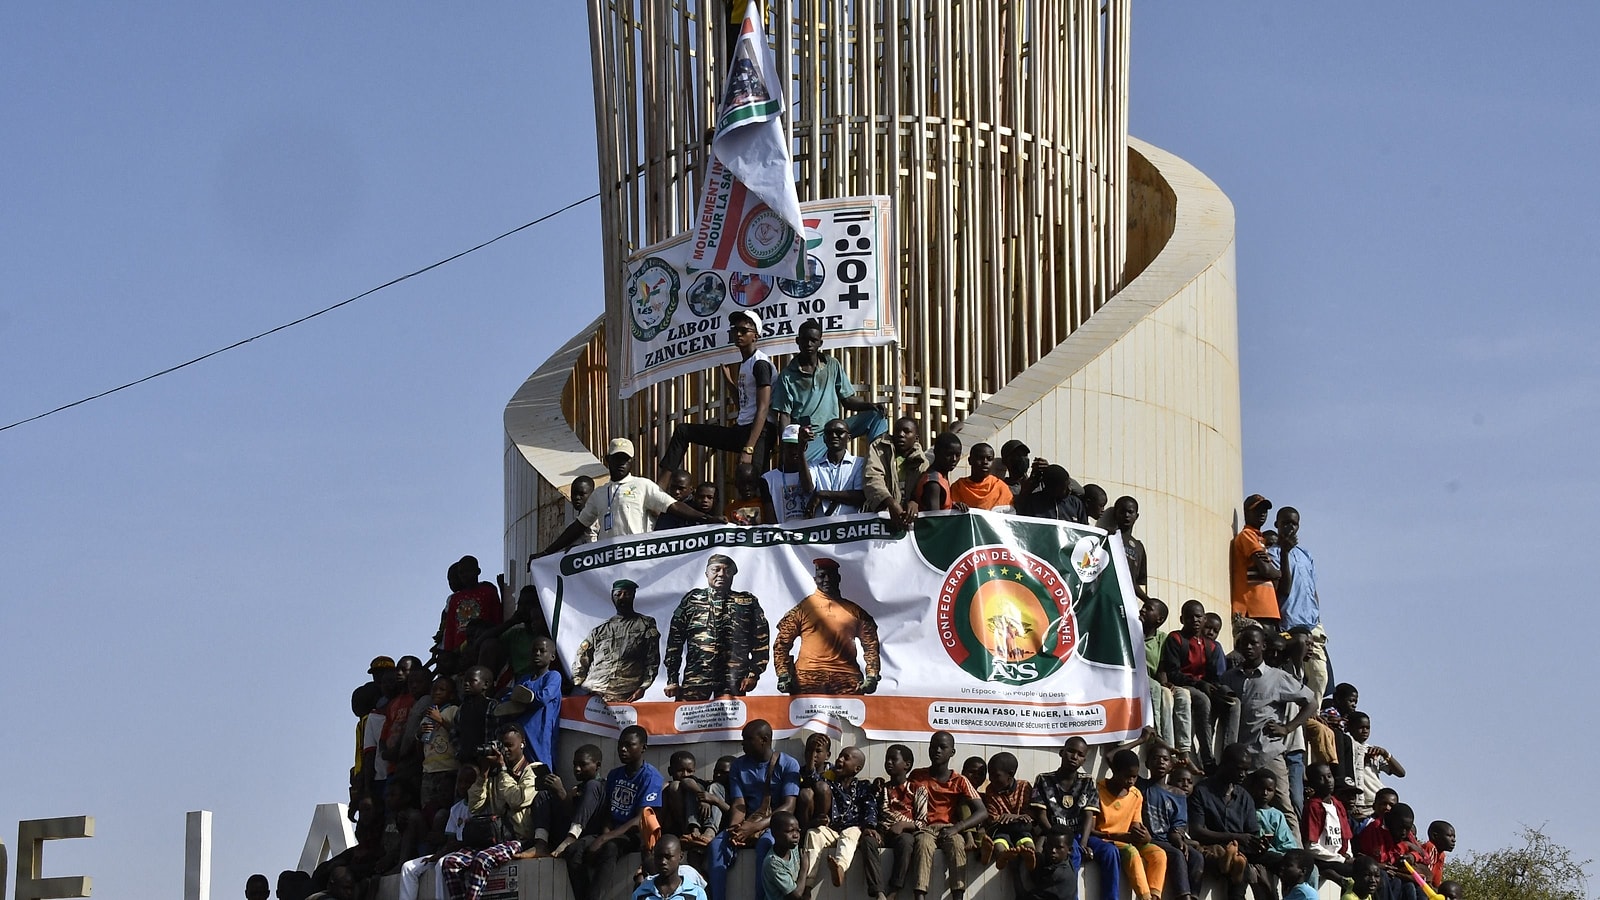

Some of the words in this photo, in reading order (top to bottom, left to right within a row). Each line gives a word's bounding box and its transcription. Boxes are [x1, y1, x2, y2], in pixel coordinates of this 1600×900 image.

[693, 178, 720, 260] MOUVEMENT
[711, 158, 723, 176] IN
[708, 213, 724, 248] POUR
[718, 194, 729, 210] LA
[667, 316, 721, 342] LABOU
[753, 302, 788, 320] NNI
[797, 299, 826, 314] NO
[644, 333, 716, 369] ZANCEN
[572, 535, 709, 569] CONFÉDÉRATION
[714, 531, 746, 544] DES
[752, 530, 804, 544] ÉTATS
[808, 529, 831, 542] DU
[836, 523, 891, 540] SAHEL
[991, 551, 1016, 561] DES
[1029, 560, 1056, 586] TATS
[940, 552, 987, 647] CONFEDERATION
[1054, 588, 1069, 605] DU
[1060, 612, 1071, 644] AHEL
[971, 688, 996, 696] Espace
[932, 718, 951, 726] AES,
[984, 719, 1016, 728] SOUVERAIN
[1059, 721, 1068, 729] DE
[948, 706, 990, 715] BURKINA
[992, 707, 1018, 717] FASO,
[1020, 709, 1030, 717] LE
[1032, 709, 1061, 718] NIGER,
[1076, 707, 1099, 716] MALI
[1329, 826, 1340, 835] Re
